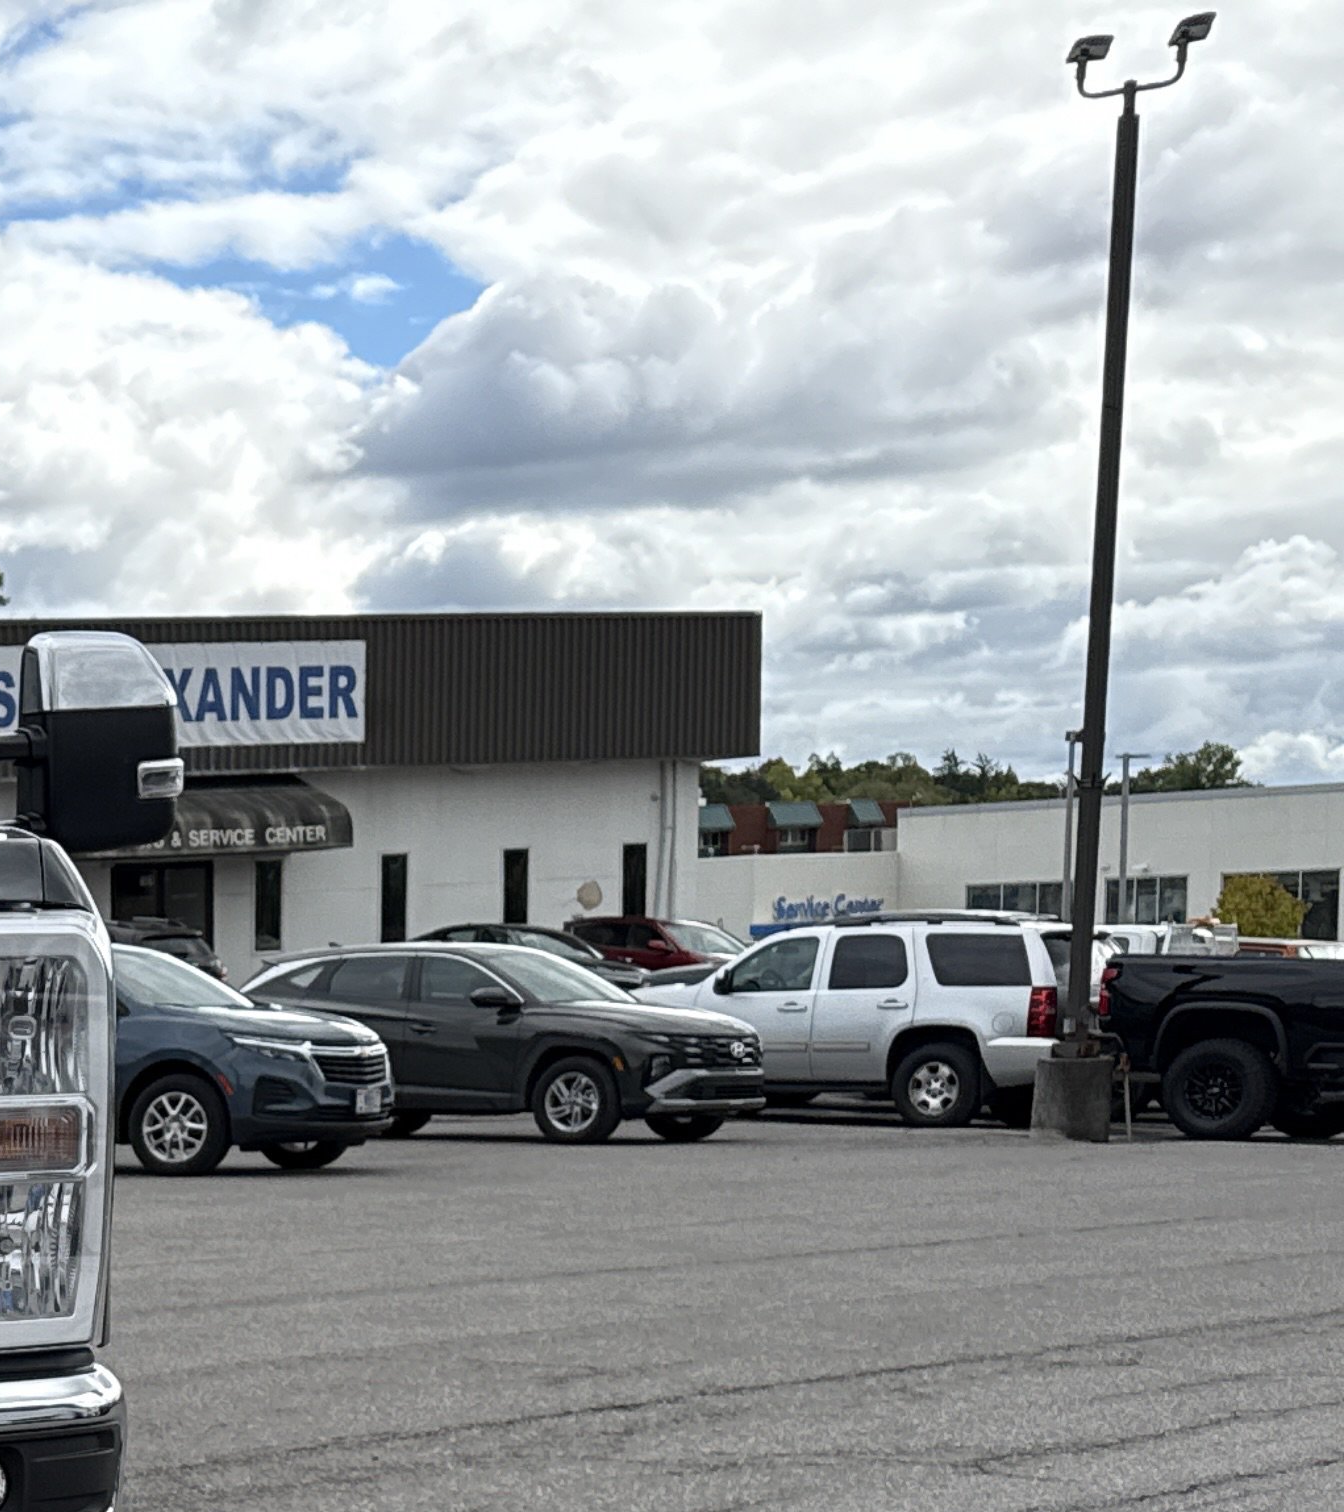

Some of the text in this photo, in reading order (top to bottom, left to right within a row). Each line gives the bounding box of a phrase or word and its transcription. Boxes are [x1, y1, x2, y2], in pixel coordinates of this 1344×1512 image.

[162, 664, 358, 723] XANDER
[171, 831, 182, 848] &
[188, 828, 255, 847] SERVICE
[265, 825, 327, 843] CENTER
